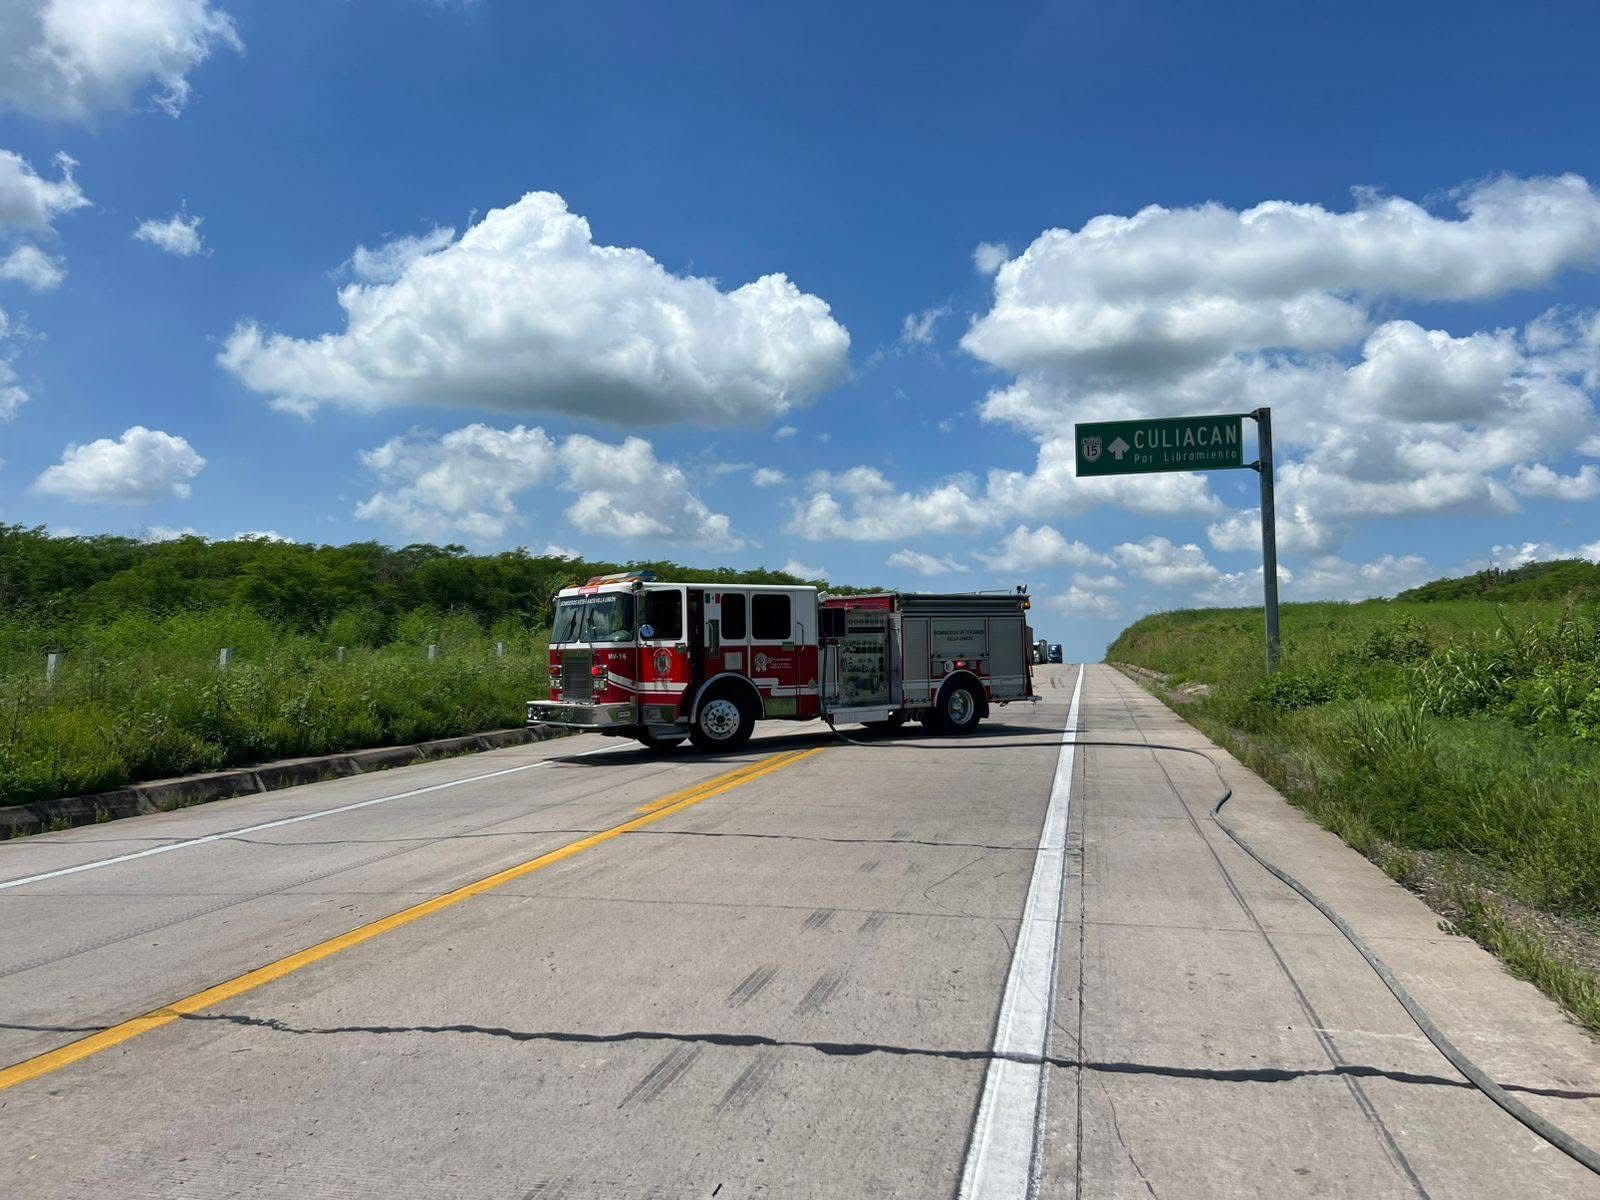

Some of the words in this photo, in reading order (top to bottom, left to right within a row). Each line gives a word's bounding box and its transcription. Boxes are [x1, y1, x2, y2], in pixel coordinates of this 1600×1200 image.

[1134, 425, 1236, 449] CULIACAN
[1087, 445, 1098, 457] 15
[1134, 453, 1153, 464] Por
[1164, 450, 1237, 462] Libramiento
